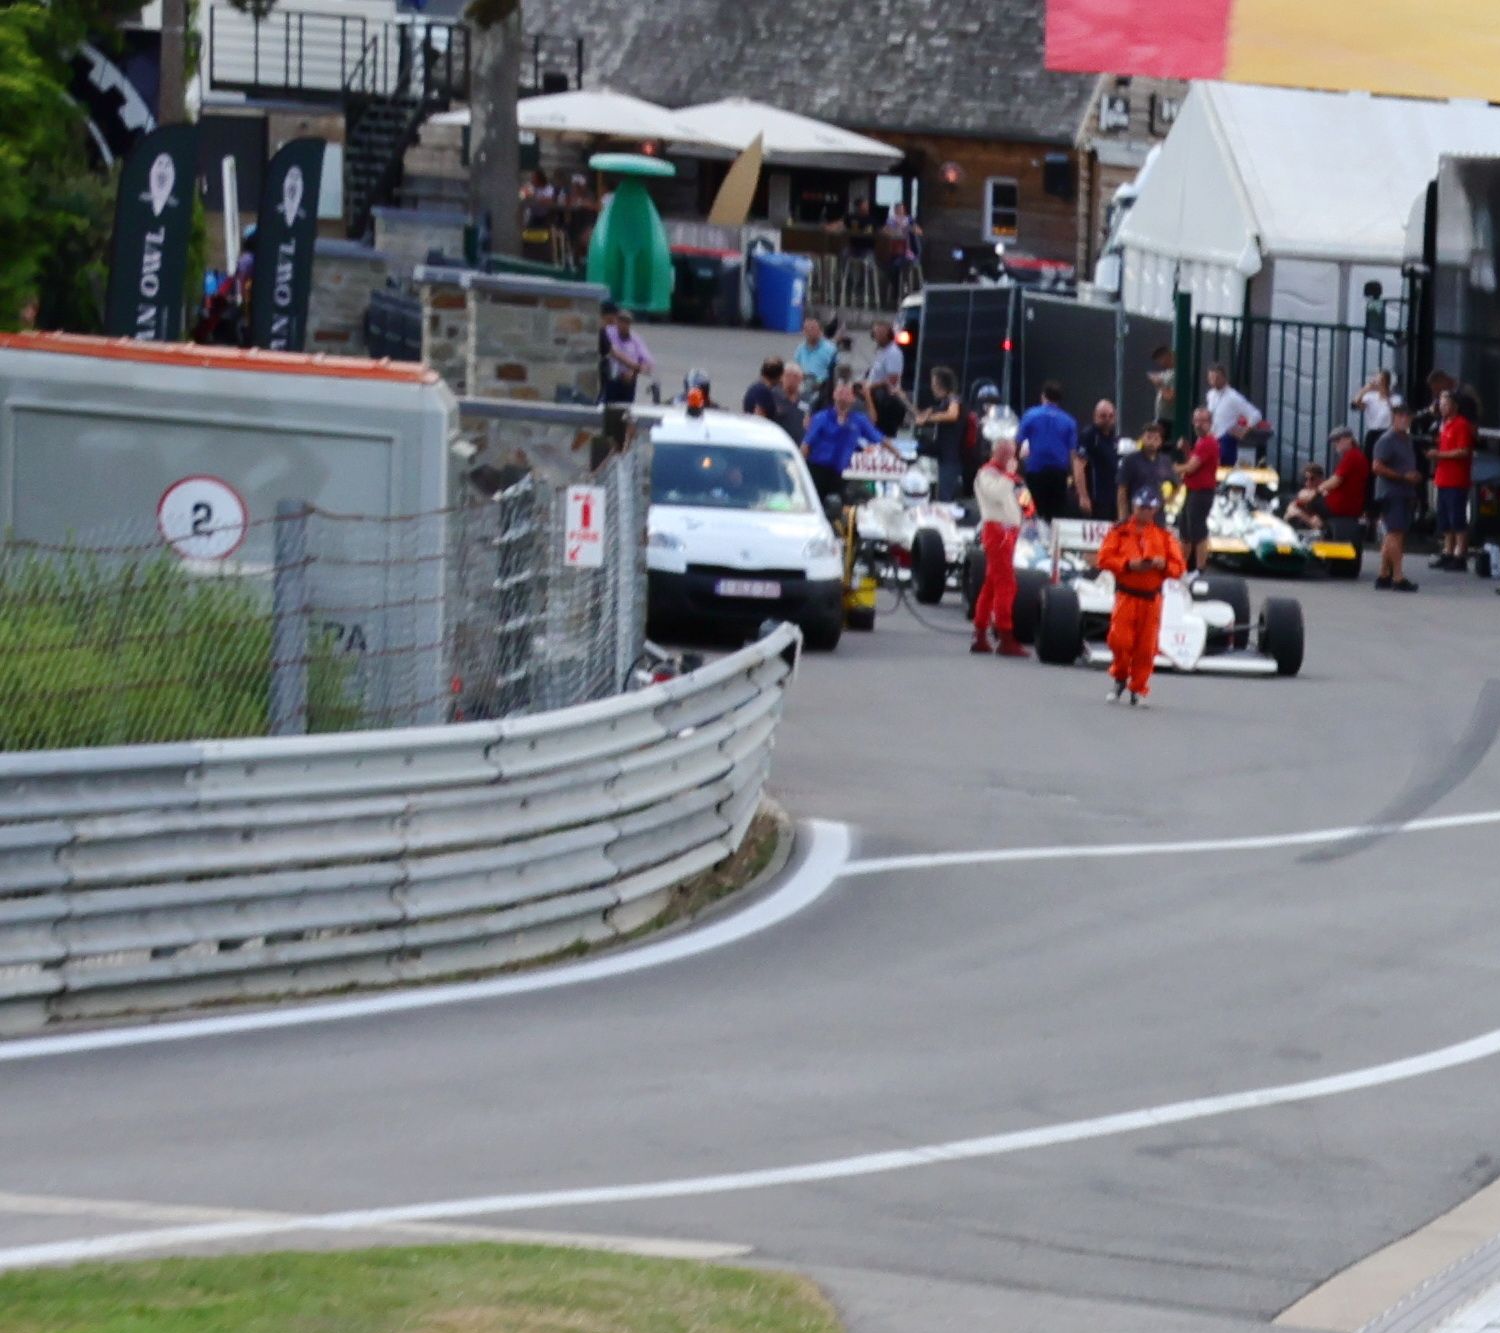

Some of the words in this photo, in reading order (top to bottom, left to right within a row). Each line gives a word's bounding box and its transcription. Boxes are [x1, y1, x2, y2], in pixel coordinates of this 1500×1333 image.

[140, 226, 165, 298] OWL
[273, 237, 296, 307] OWL
[191, 502, 214, 538] 2
